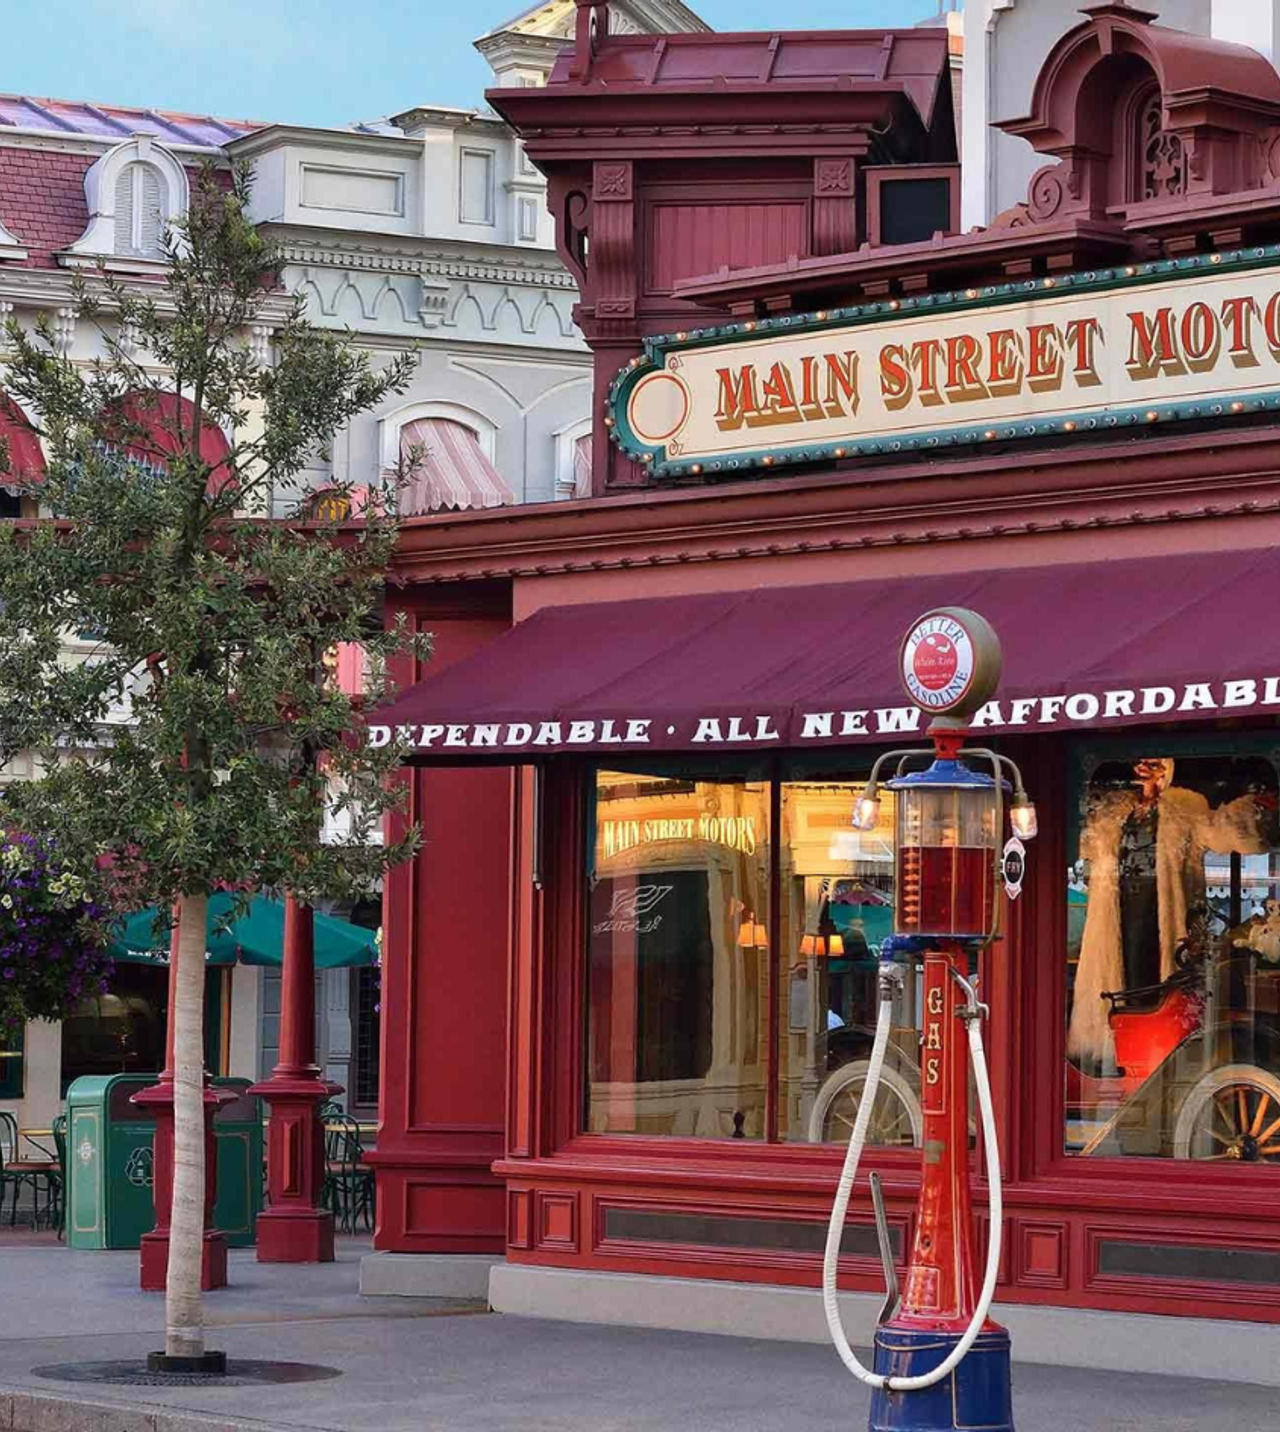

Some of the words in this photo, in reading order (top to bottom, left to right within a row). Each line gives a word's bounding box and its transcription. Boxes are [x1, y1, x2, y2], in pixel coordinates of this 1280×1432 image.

[714, 350, 861, 430] MAIN
[879, 317, 1104, 411] STREET
[911, 618, 965, 646] BETTER
[907, 670, 968, 705] GASOLINE
[366, 719, 652, 748] DEPENDABLE
[691, 717, 779, 742] ALL
[801, 706, 921, 737] NEW
[603, 820, 640, 859] MAIN
[644, 818, 694, 843] STREET
[699, 816, 755, 856] MOTORS
[926, 987, 943, 1084] GAS
